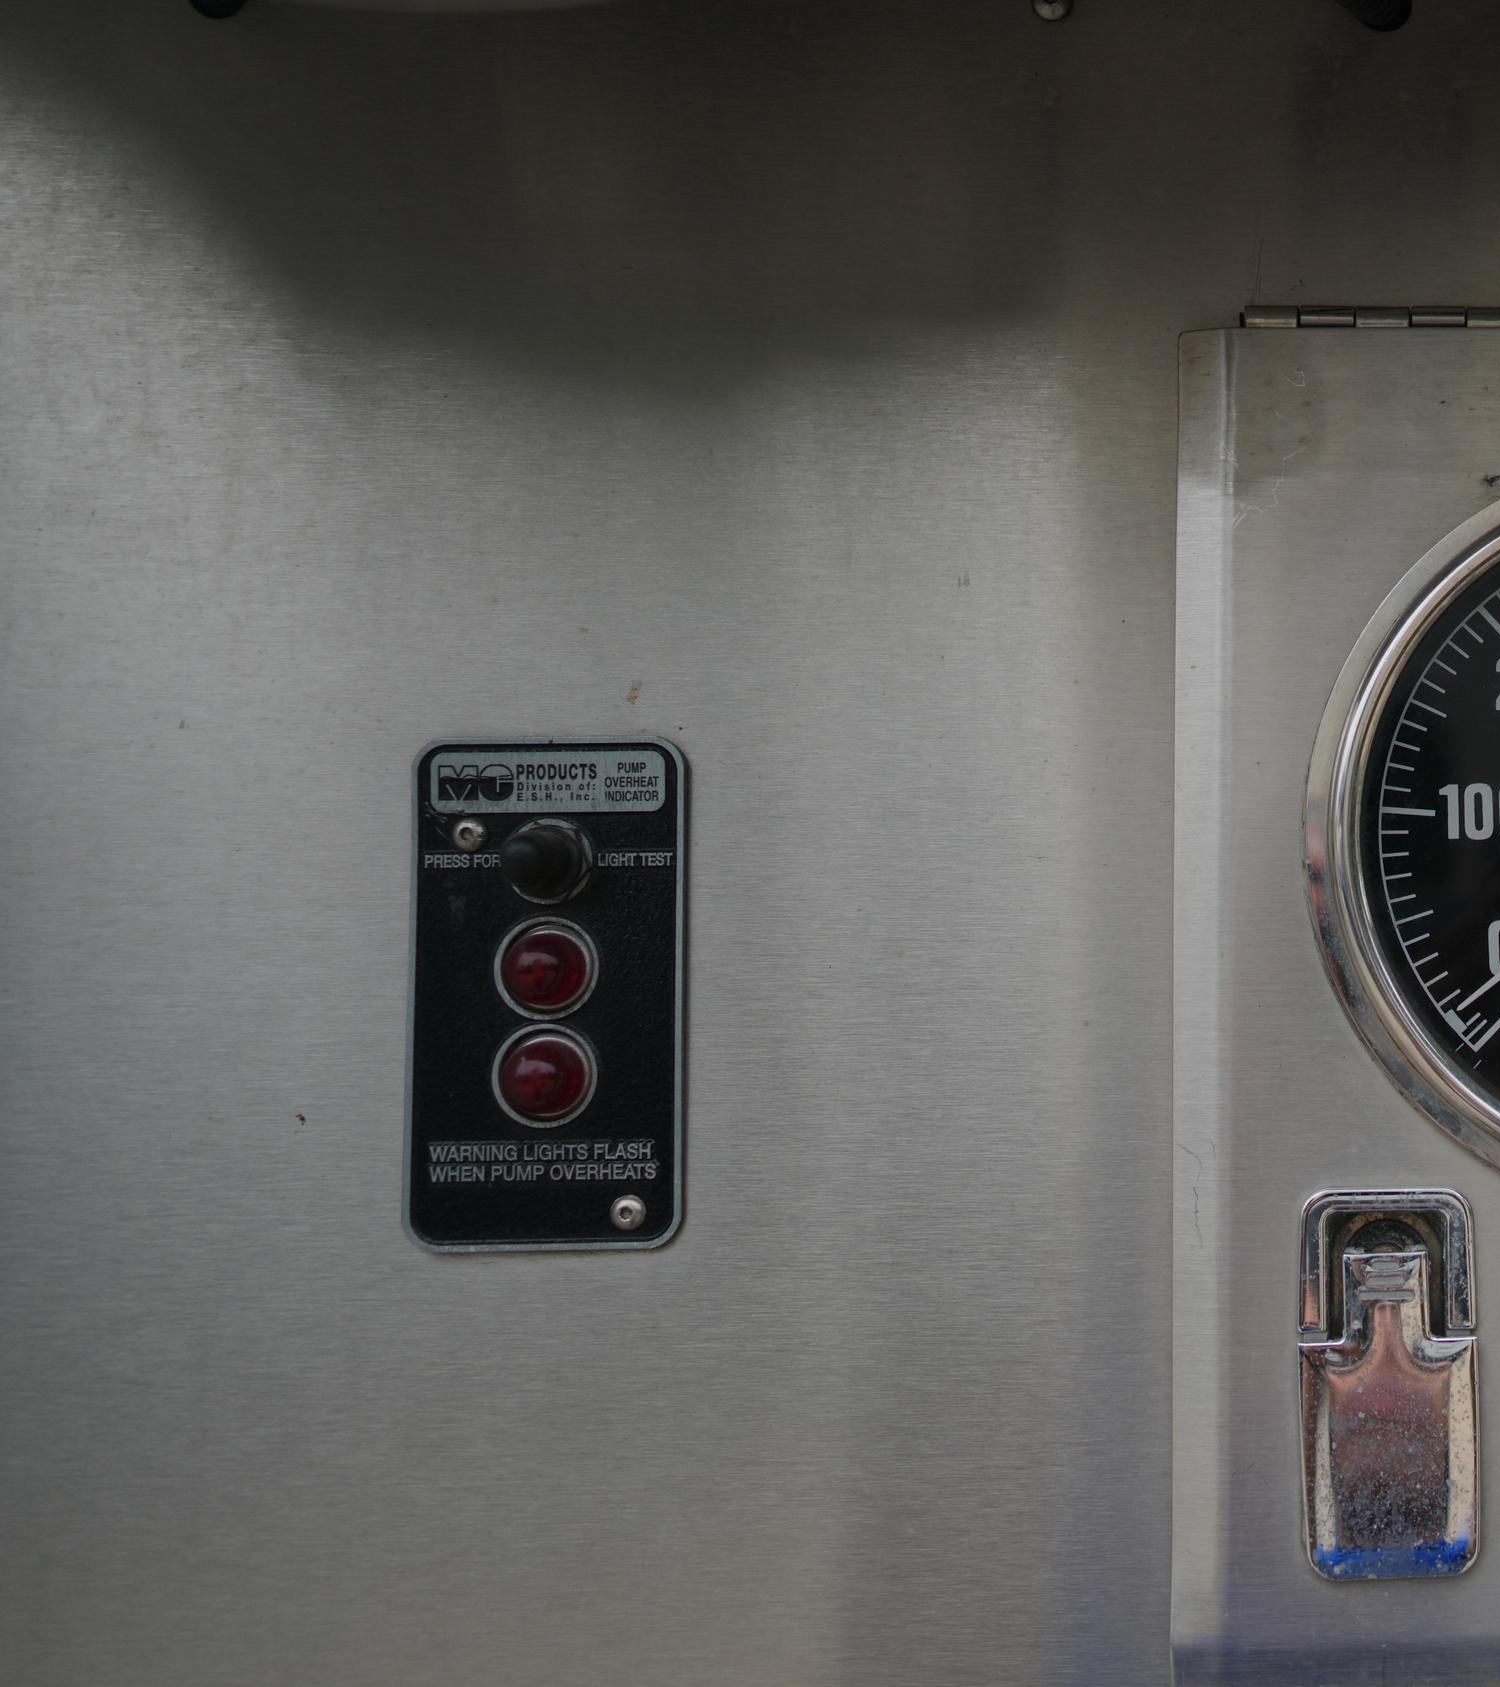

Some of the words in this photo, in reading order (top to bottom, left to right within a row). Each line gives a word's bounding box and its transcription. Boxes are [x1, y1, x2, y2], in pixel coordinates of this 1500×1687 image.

[516, 764, 597, 780] PRODUCTS
[617, 763, 646, 774] PUMP
[517, 782, 571, 791] Division
[604, 776, 659, 788] OVERHEAT
[570, 792, 596, 801] Inc.
[605, 790, 659, 802] INDICATOR
[424, 854, 470, 868] PRESS
[598, 853, 638, 867] LIGHT
[640, 852, 673, 867] TEST
[429, 1145, 518, 1162] WARNING
[523, 1144, 588, 1161] LIGHTS
[594, 1142, 651, 1160] FLASH
[429, 1166, 485, 1183] WHEN
[491, 1165, 544, 1181] PUMP
[550, 1163, 656, 1181] OVERHEATS
